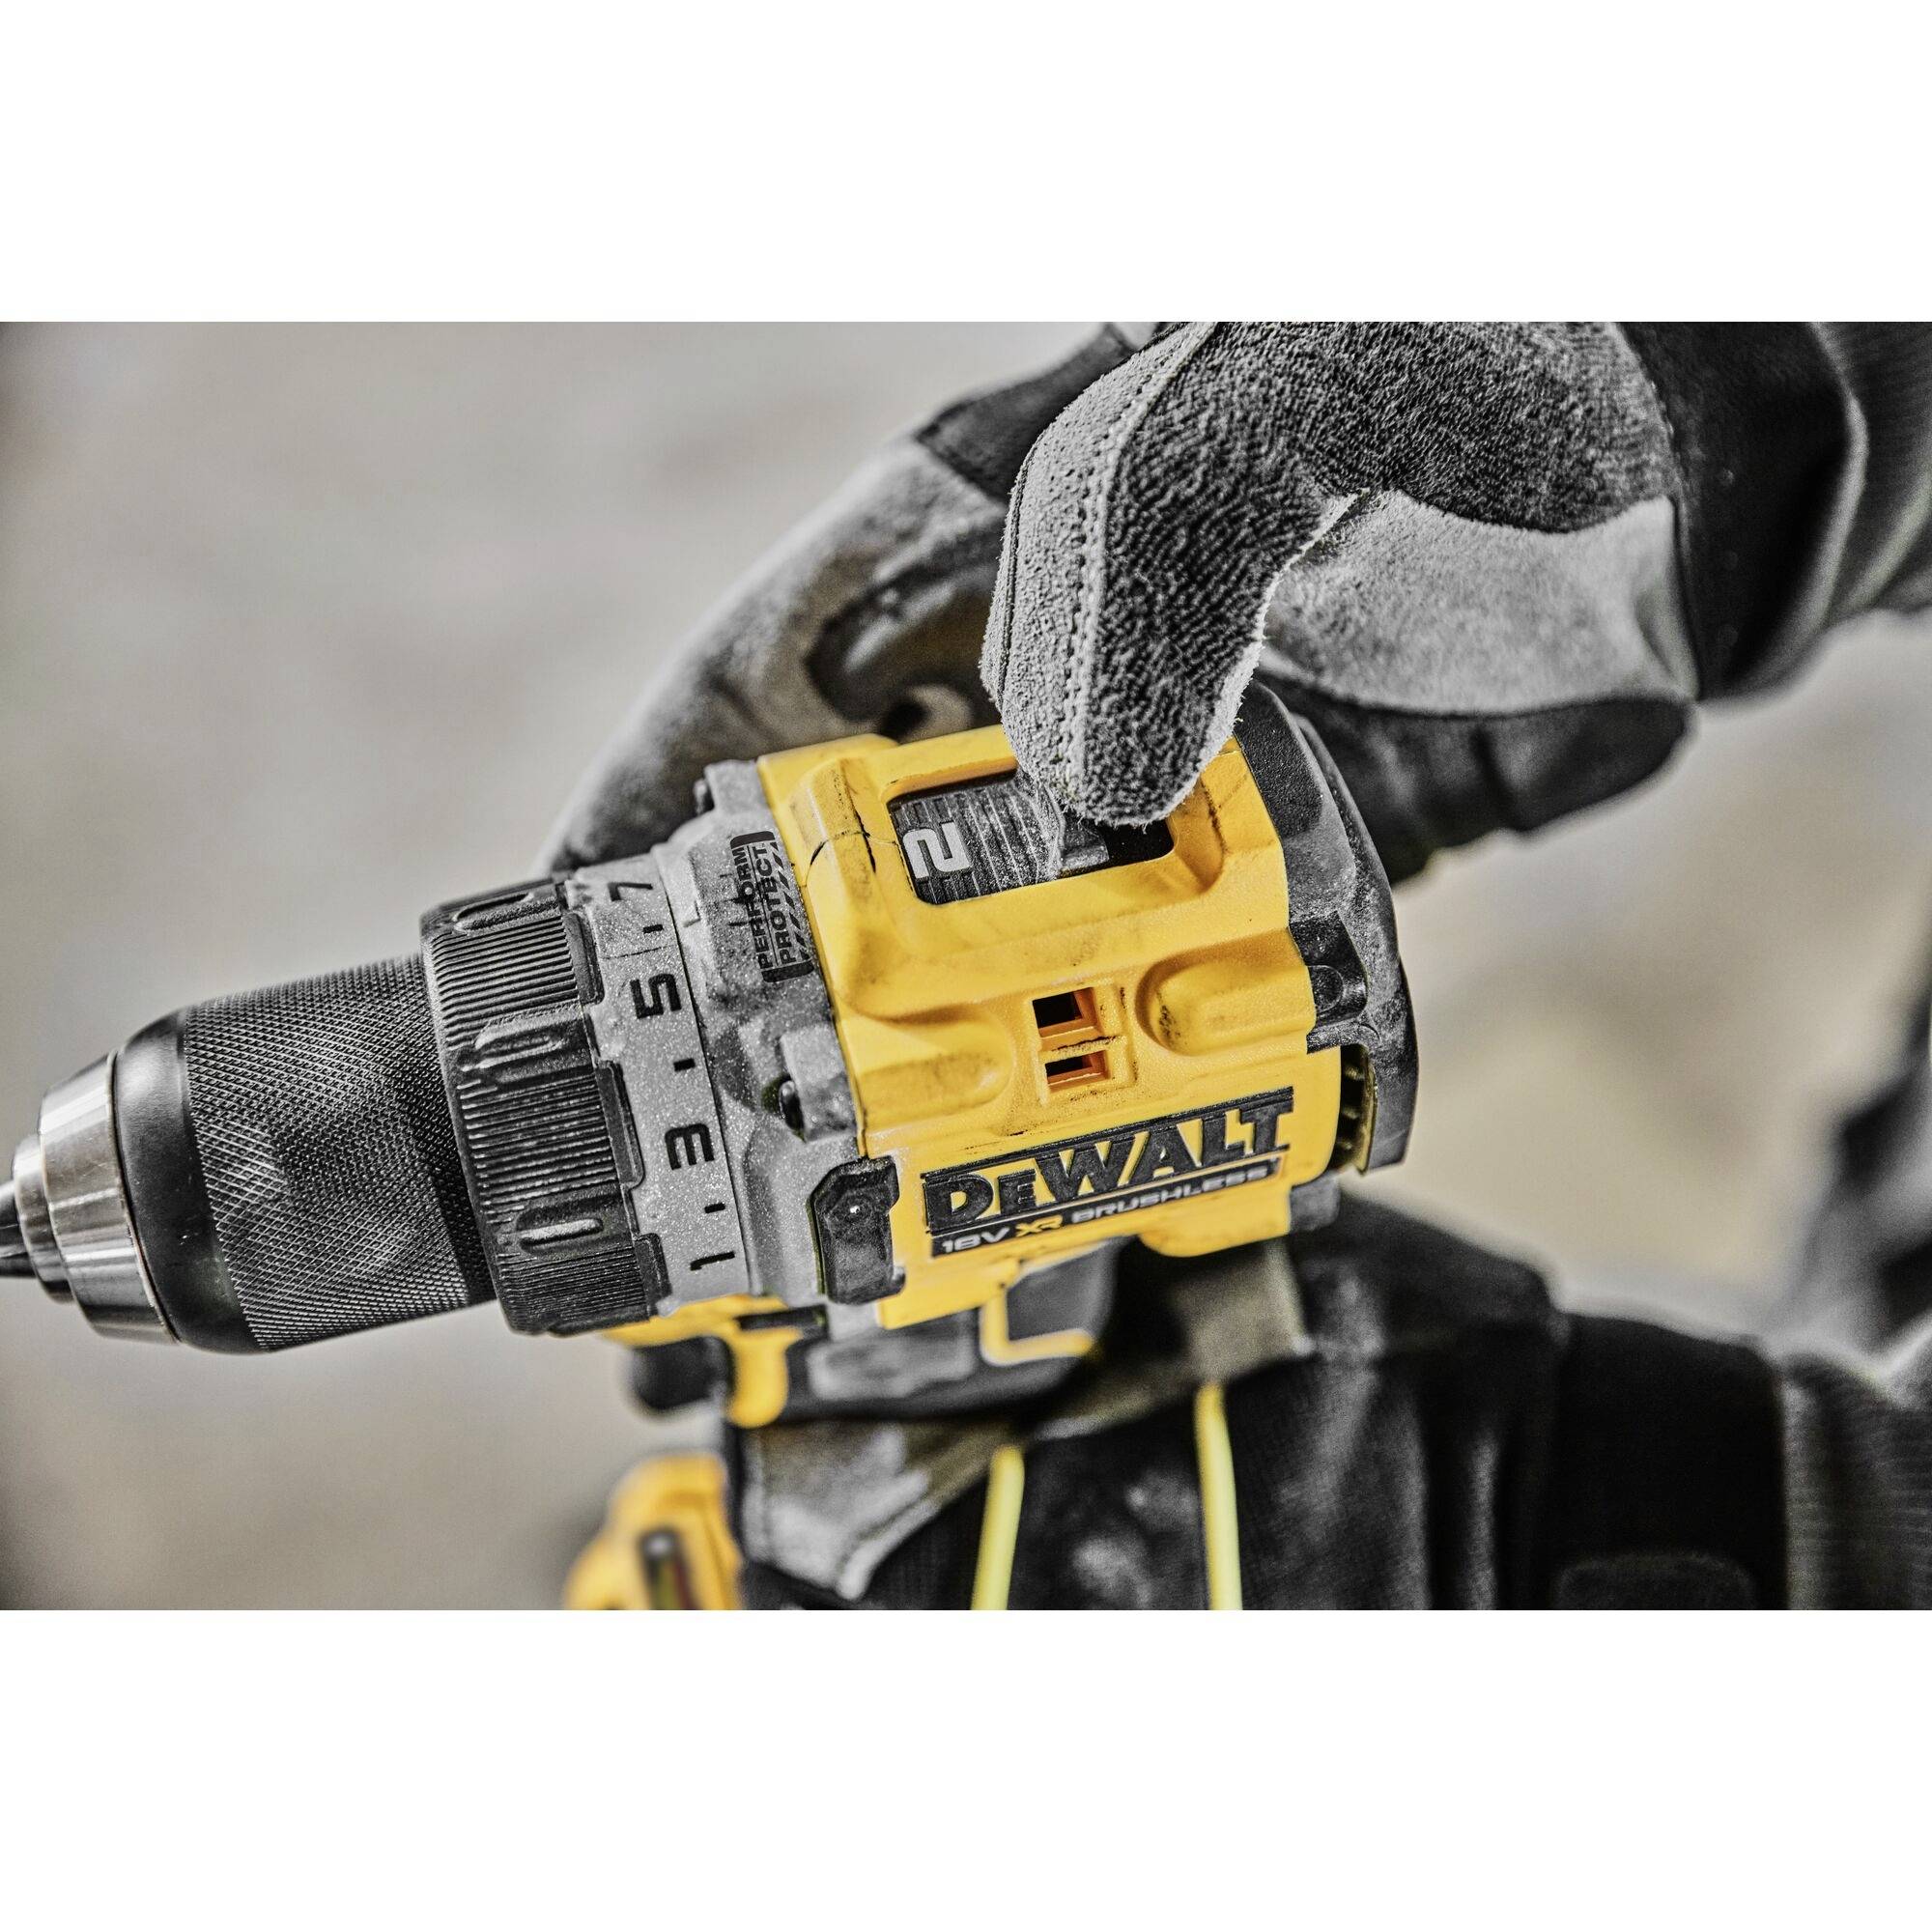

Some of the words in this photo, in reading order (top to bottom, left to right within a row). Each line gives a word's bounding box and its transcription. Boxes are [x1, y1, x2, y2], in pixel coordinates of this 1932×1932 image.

[902, 821, 972, 879] 2
[608, 881, 654, 902] 7
[752, 845, 797, 965] PROTECT
[630, 973, 682, 1019] 5
[665, 1123, 715, 1171] 3
[942, 1226, 1010, 1253] 18V
[1015, 1215, 1064, 1237] XR
[1071, 1165, 1268, 1224] BRUSHLESS
[690, 1251, 735, 1271] 1
